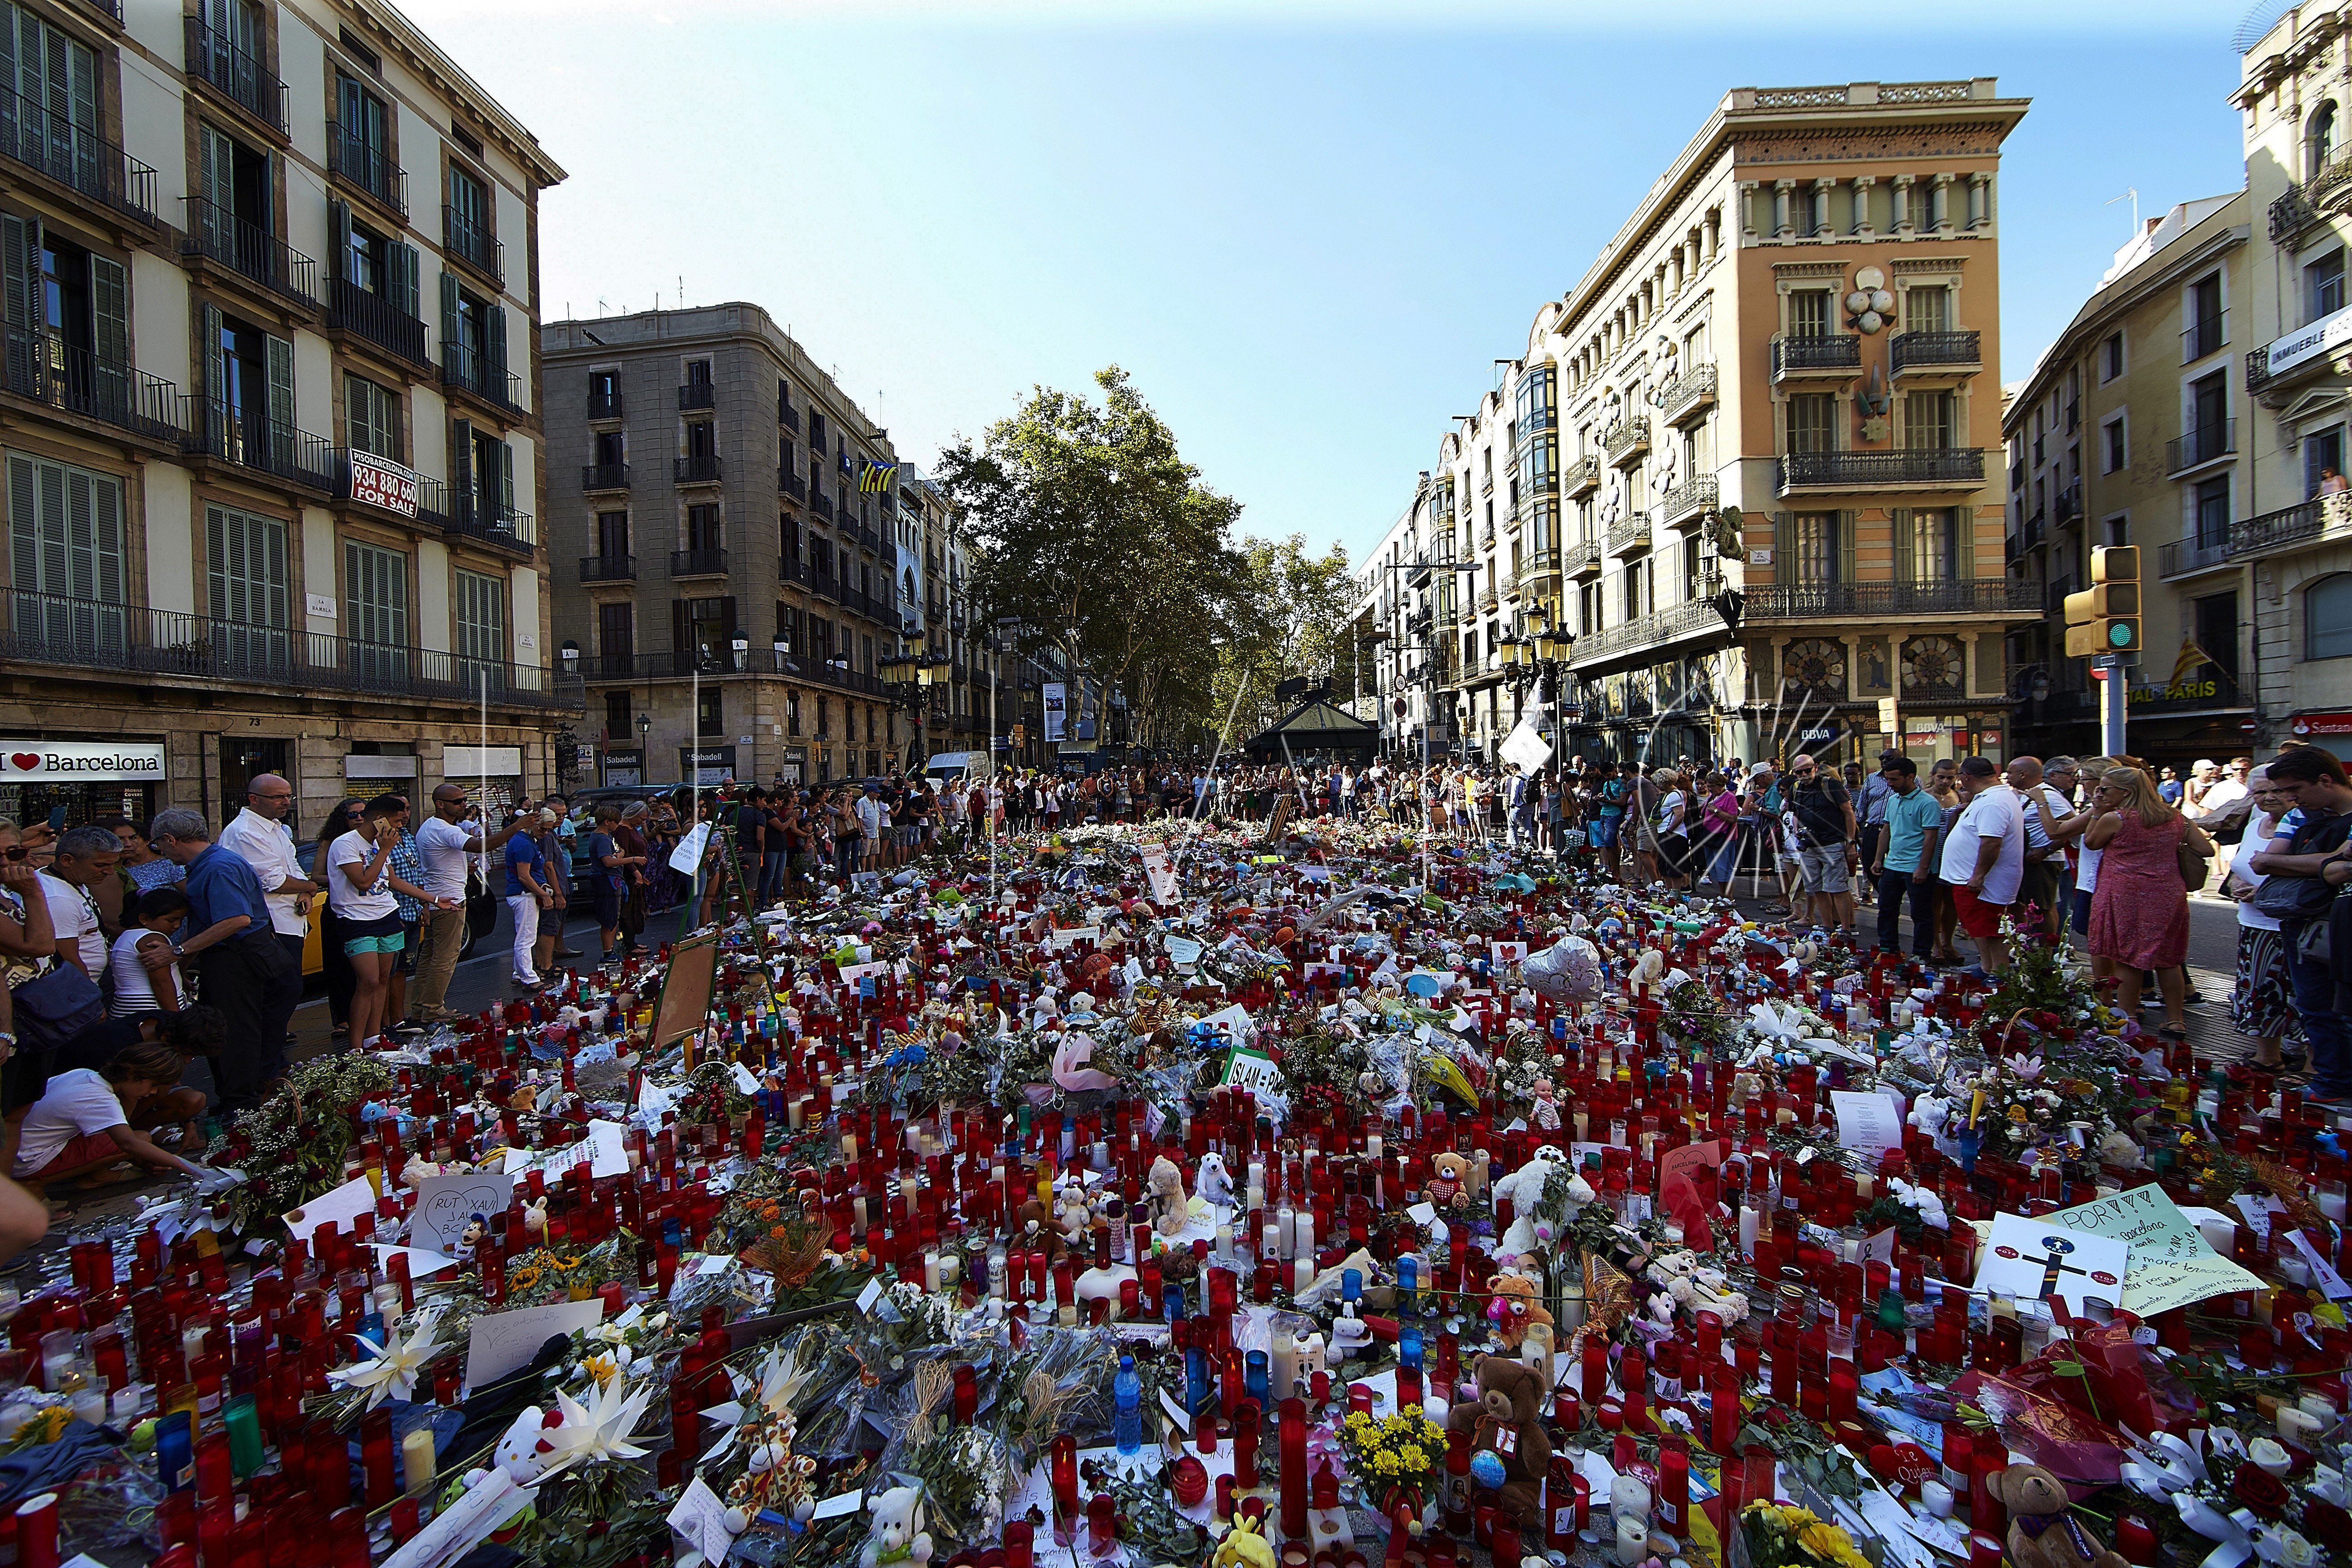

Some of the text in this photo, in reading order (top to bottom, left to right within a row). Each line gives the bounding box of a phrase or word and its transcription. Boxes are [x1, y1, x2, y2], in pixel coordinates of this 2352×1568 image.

[354, 452, 414, 480] PISOBARCELONA.COM
[354, 465, 416, 503] 934 880 660
[358, 486, 414, 515] FOR SALE
[2165, 681, 2216, 701] PARIS
[249, 718, 260, 727] 73
[1917, 723, 1945, 733] BBVA
[1802, 729, 1830, 740] BBVA
[44, 753, 159, 771] Barcelona
[607, 755, 636, 764] Sabadell
[691, 753, 721, 761] Sabadell
[1230, 1061, 1261, 1089] ISLAM
[1671, 1160, 1698, 1171] BARCELONA
[435, 1196, 497, 1210] RUT XAVI
[2120, 1220, 2167, 1241] Barcelona
[2143, 1256, 2179, 1268] more
[2067, 1514, 2092, 1556] BARCELONA
